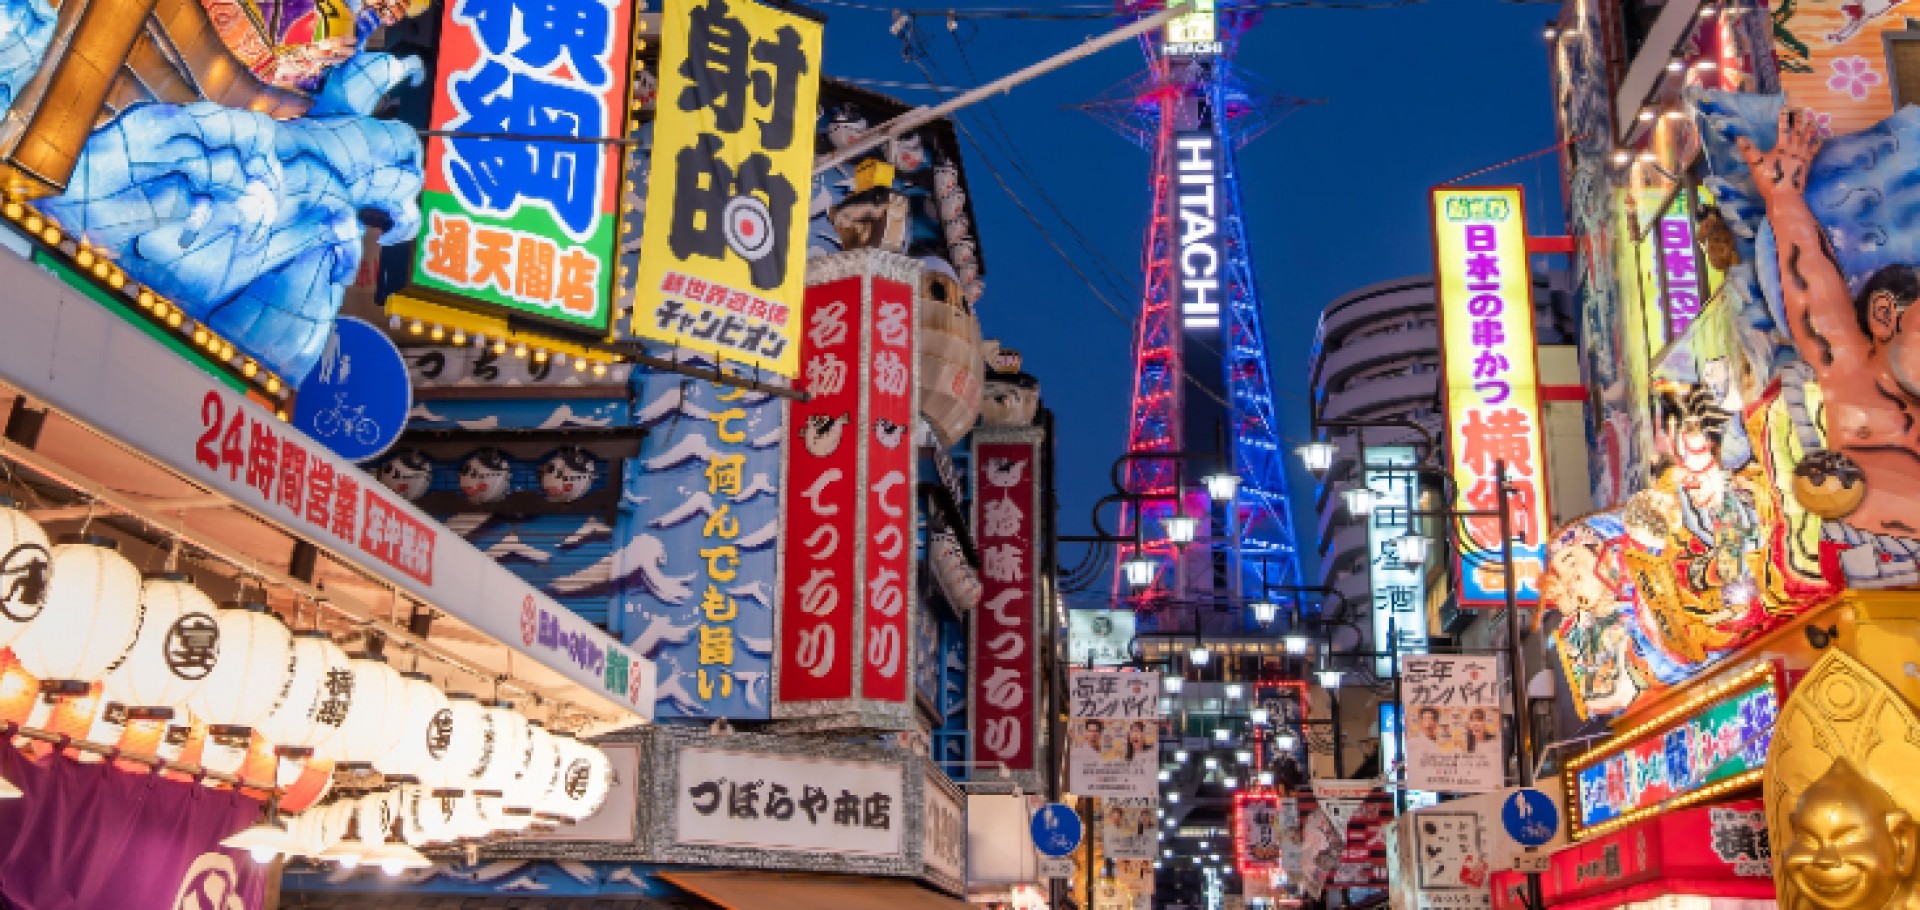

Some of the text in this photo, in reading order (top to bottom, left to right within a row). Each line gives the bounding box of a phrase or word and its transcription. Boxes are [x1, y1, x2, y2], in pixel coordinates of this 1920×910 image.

[1162, 42, 1222, 55] HITACHI
[668, 0, 808, 290] 射的
[426, 214, 600, 315] 通天閣店
[1177, 138, 1220, 328] HITACHI
[655, 300, 789, 359] チャンピオン
[804, 300, 849, 398] 名物
[871, 300, 909, 397] 名物
[1465, 224, 1510, 404] 日本一の串かつ
[195, 389, 360, 545] 24時間営業
[1460, 407, 1538, 547] 横綱
[697, 368, 748, 702] って何んでも旨い
[688, 777, 893, 831] づぼらや本店
